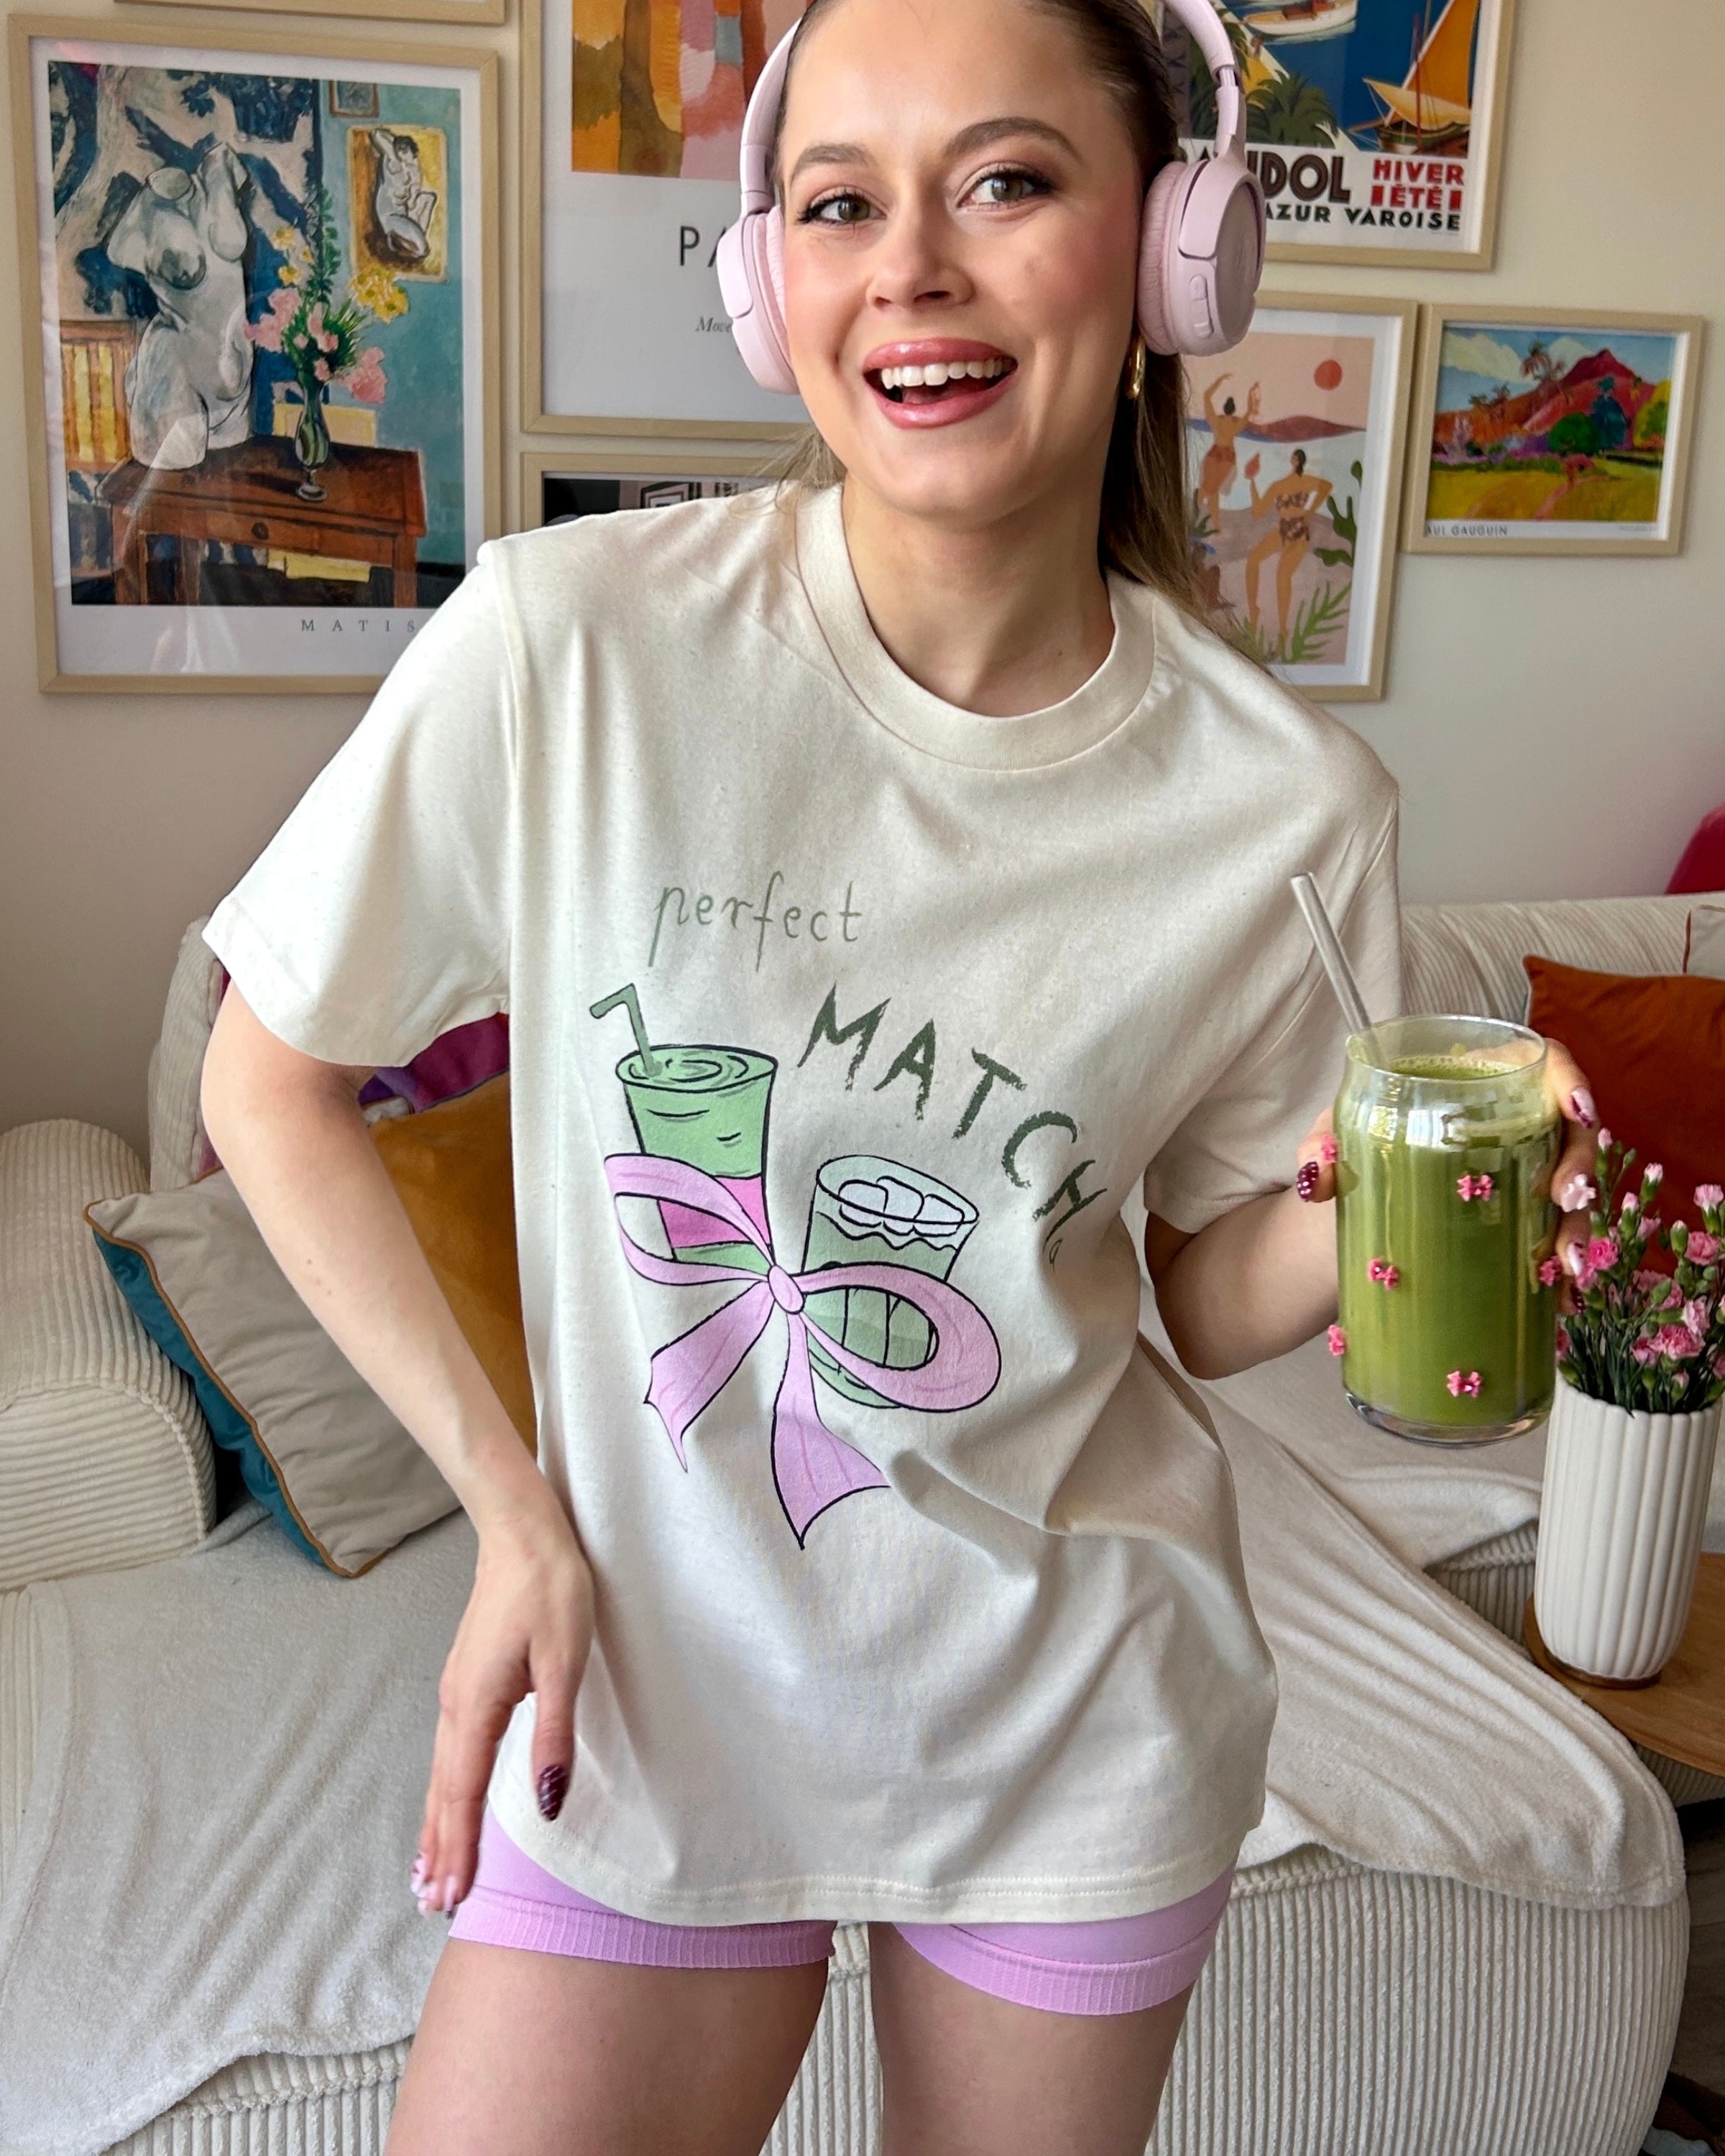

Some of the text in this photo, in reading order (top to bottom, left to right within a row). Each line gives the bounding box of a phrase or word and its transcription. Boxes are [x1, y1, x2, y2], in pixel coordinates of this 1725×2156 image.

[1200, 146, 1351, 204] DOL
[1373, 158, 1465, 186] HIVER
[1344, 207, 1460, 231] VAROISE
[1451, 525, 1508, 537] GAUGUIN
[300, 619, 415, 632] MATIS
[648, 870, 862, 972] perfect
[797, 980, 1108, 1272] MATCH
